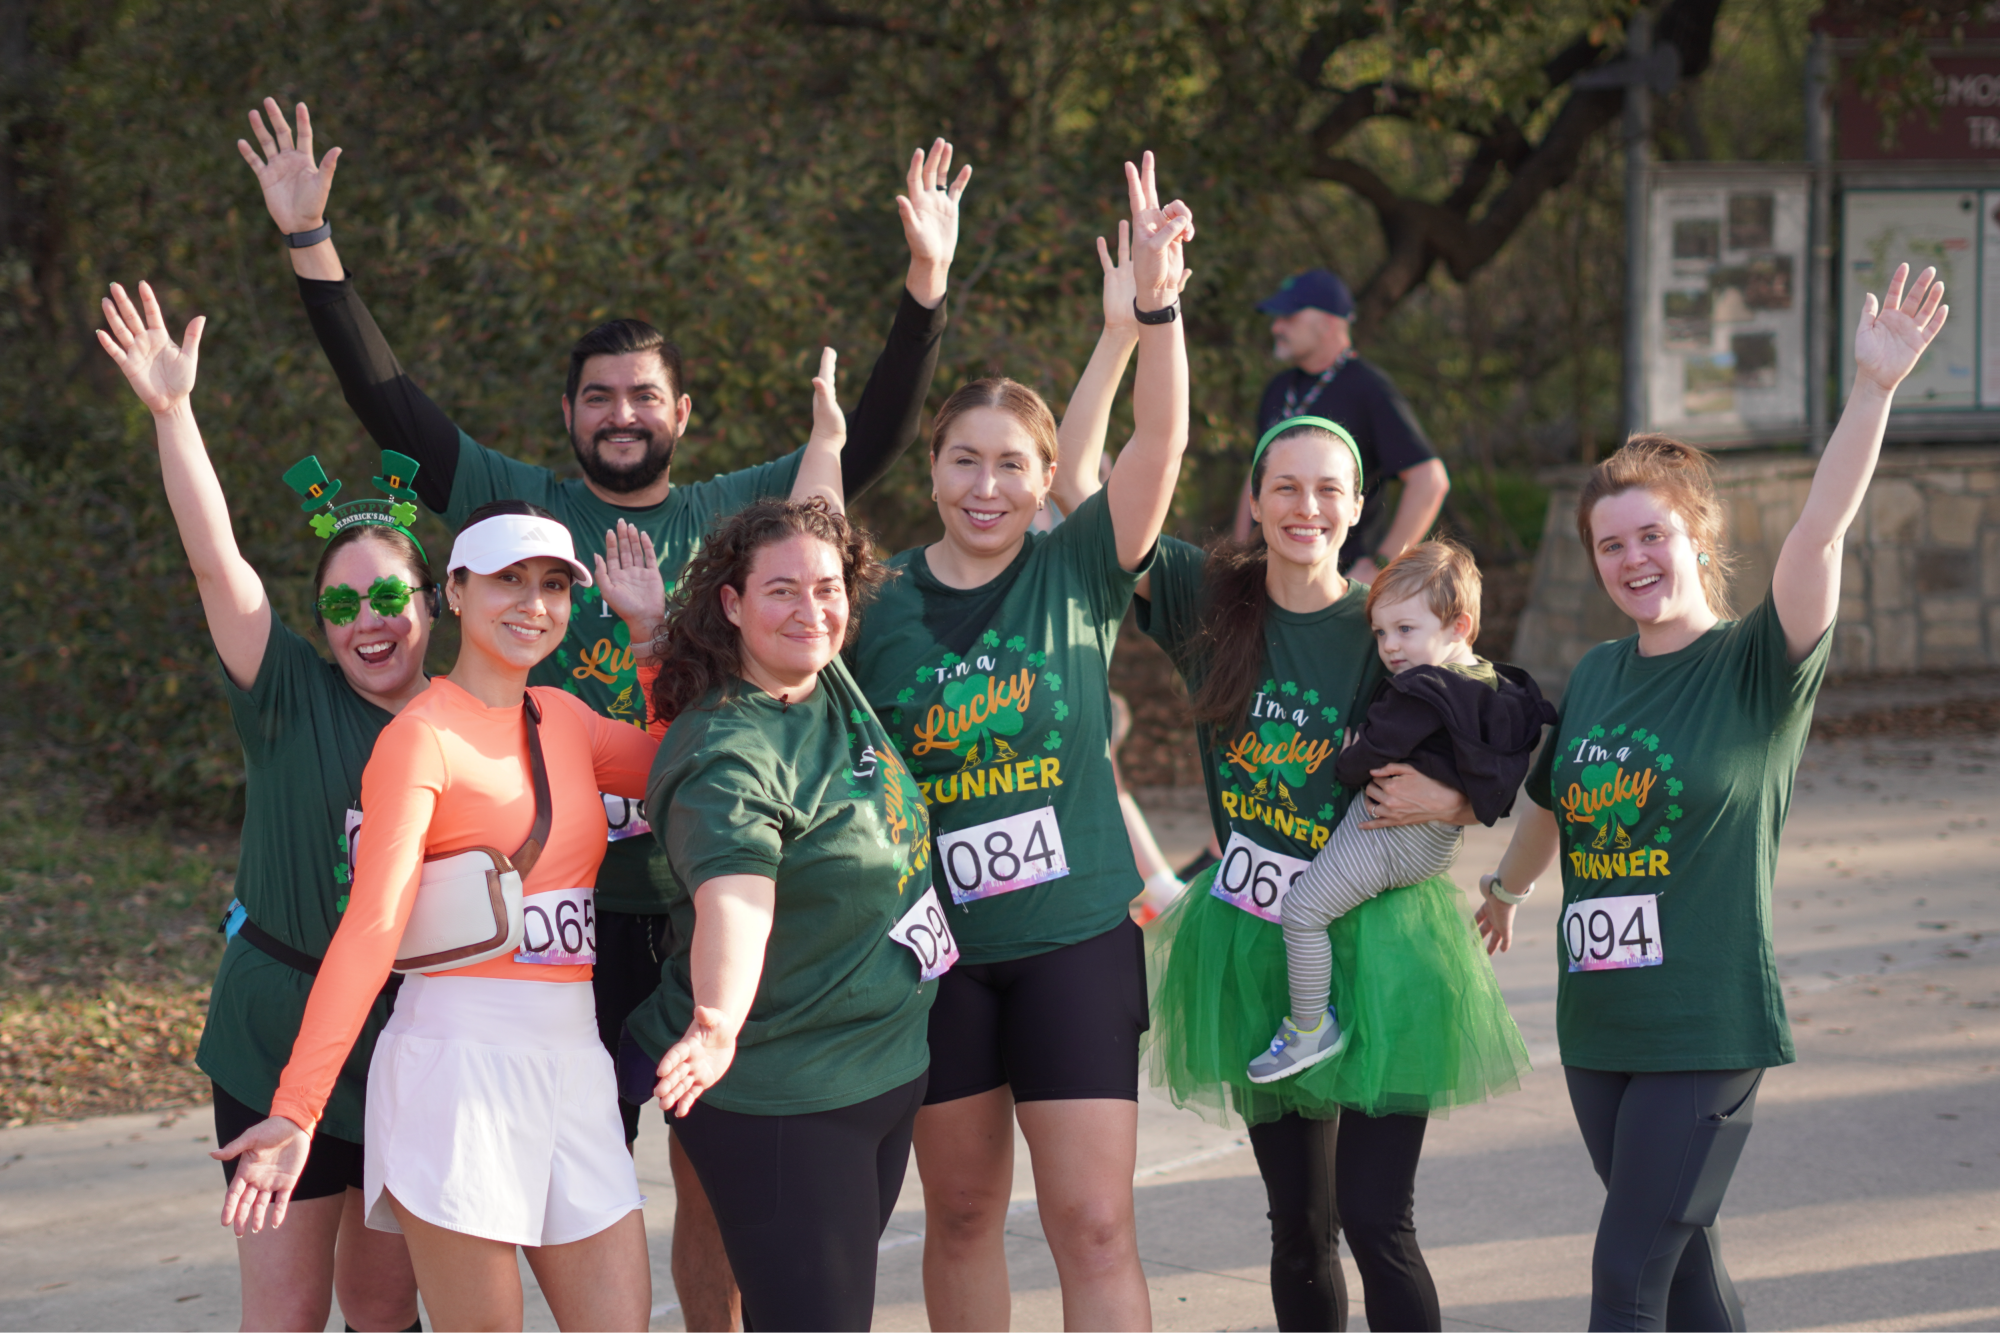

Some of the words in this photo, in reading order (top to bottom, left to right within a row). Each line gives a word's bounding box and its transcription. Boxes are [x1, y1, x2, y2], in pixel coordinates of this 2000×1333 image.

[338, 504, 386, 517] HAPPY
[976, 655, 996, 671] a
[912, 668, 1036, 756] Lucky
[1251, 692, 1287, 720] I'm
[1292, 709, 1309, 727] a
[1225, 731, 1334, 775] Lucky
[1616, 746, 1632, 762] a
[1221, 790, 1330, 850] RUNNER
[1560, 767, 1657, 823] Lucky
[946, 820, 1057, 892] 084
[1221, 846, 1304, 909] 06
[1568, 849, 1671, 880] RUNNER
[523, 899, 597, 954] 065
[1566, 906, 1653, 963] 094
